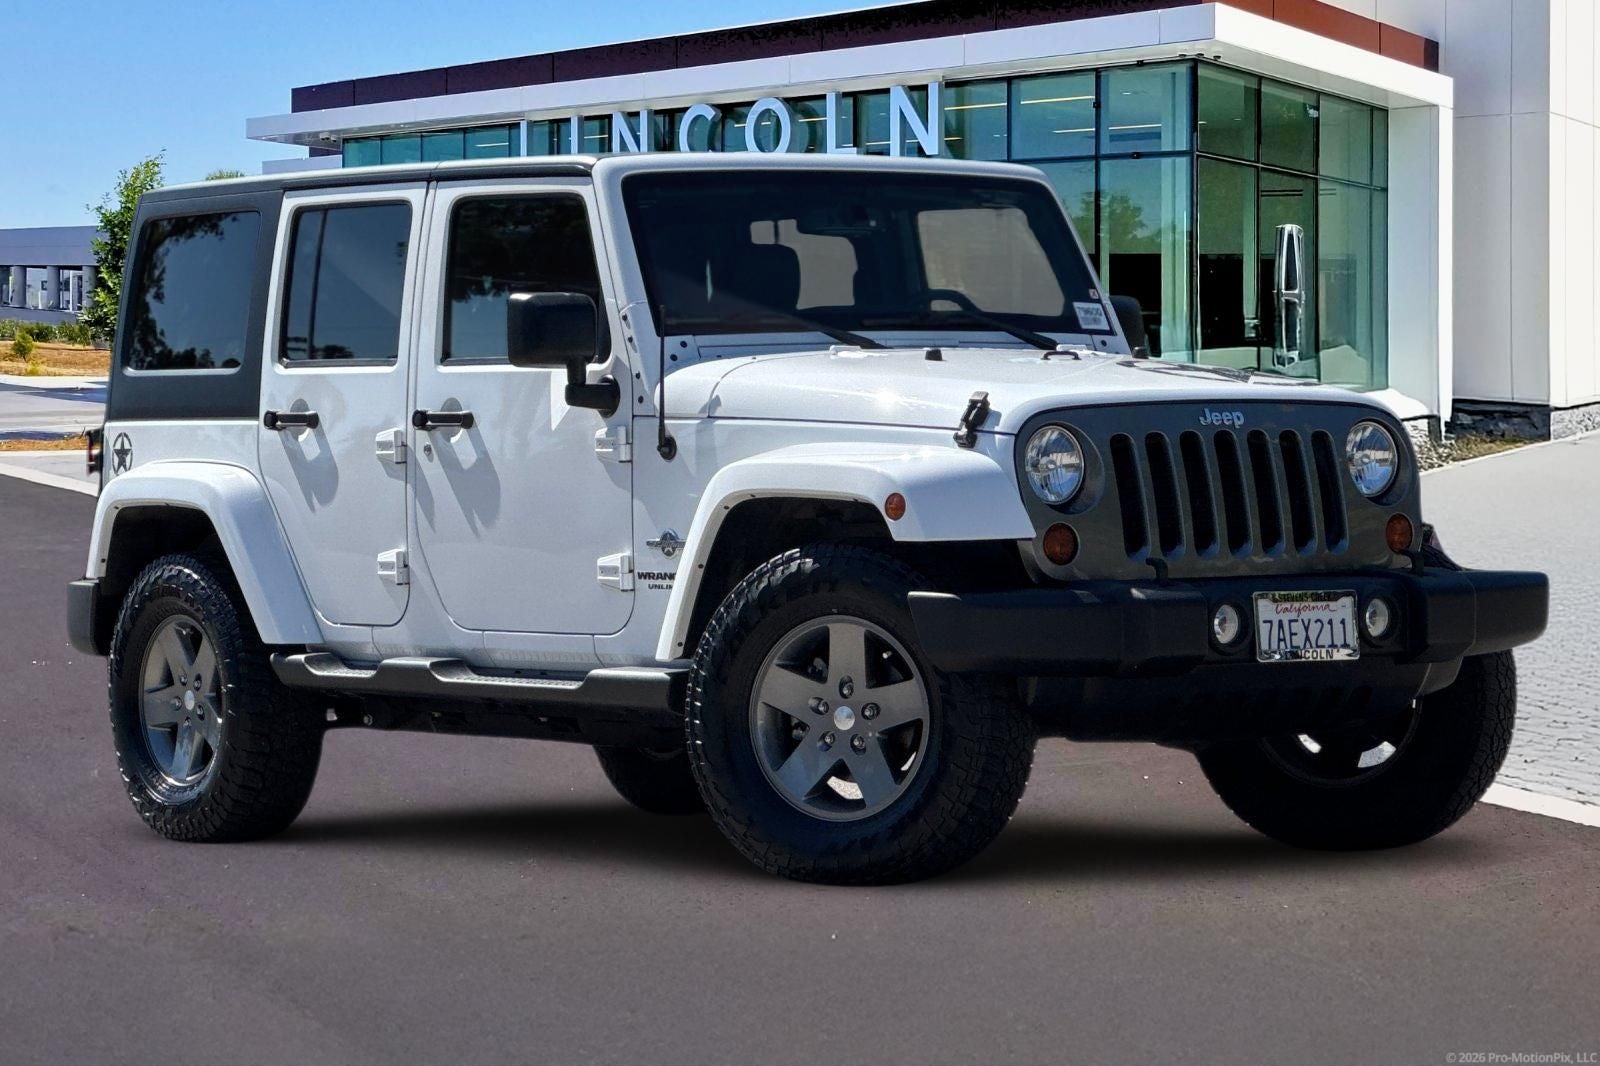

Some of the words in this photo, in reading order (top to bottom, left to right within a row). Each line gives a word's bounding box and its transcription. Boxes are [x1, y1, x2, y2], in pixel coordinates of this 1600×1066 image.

[1199, 408, 1245, 429] Jeep
[1275, 603, 1336, 618] California
[1262, 618, 1351, 650] 7AEX211
